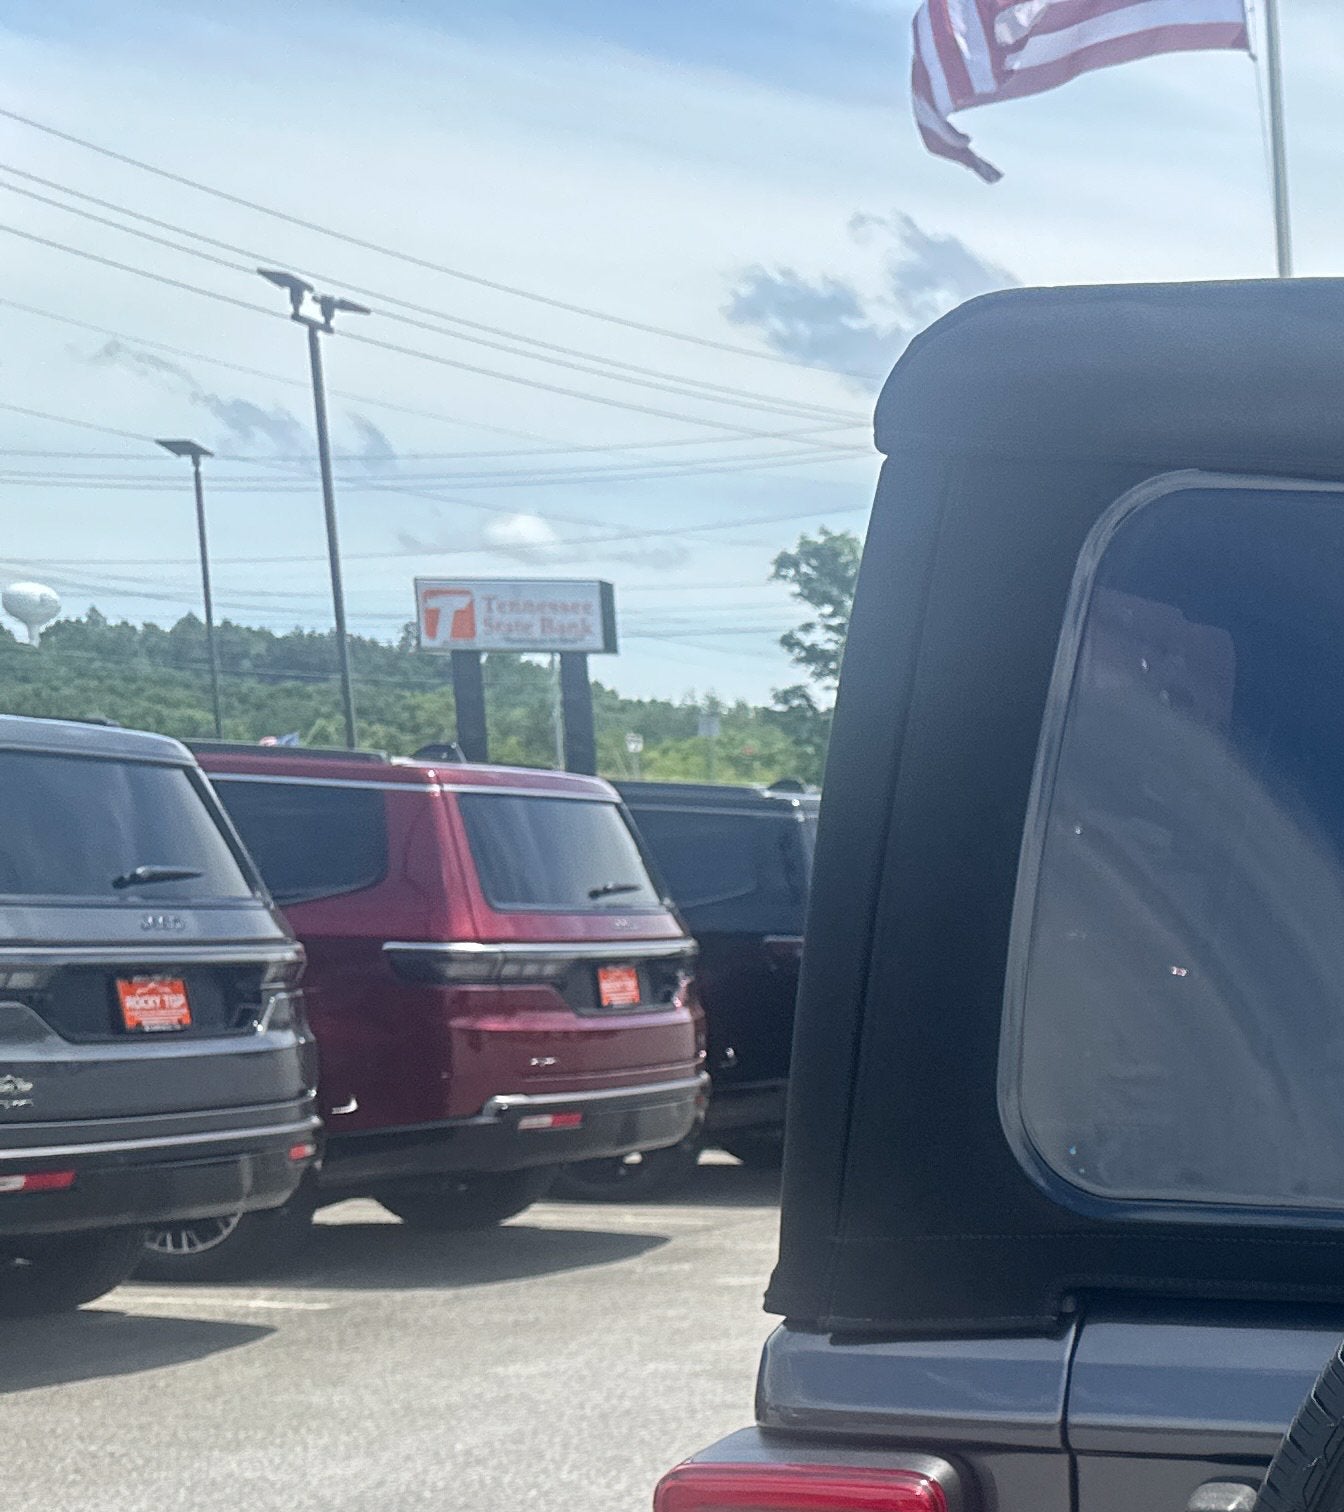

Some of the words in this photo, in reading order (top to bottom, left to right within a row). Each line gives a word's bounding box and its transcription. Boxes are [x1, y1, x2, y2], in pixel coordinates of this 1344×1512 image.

[481, 594, 593, 614] Tennessee
[483, 617, 533, 634] State
[540, 616, 593, 635] Bank
